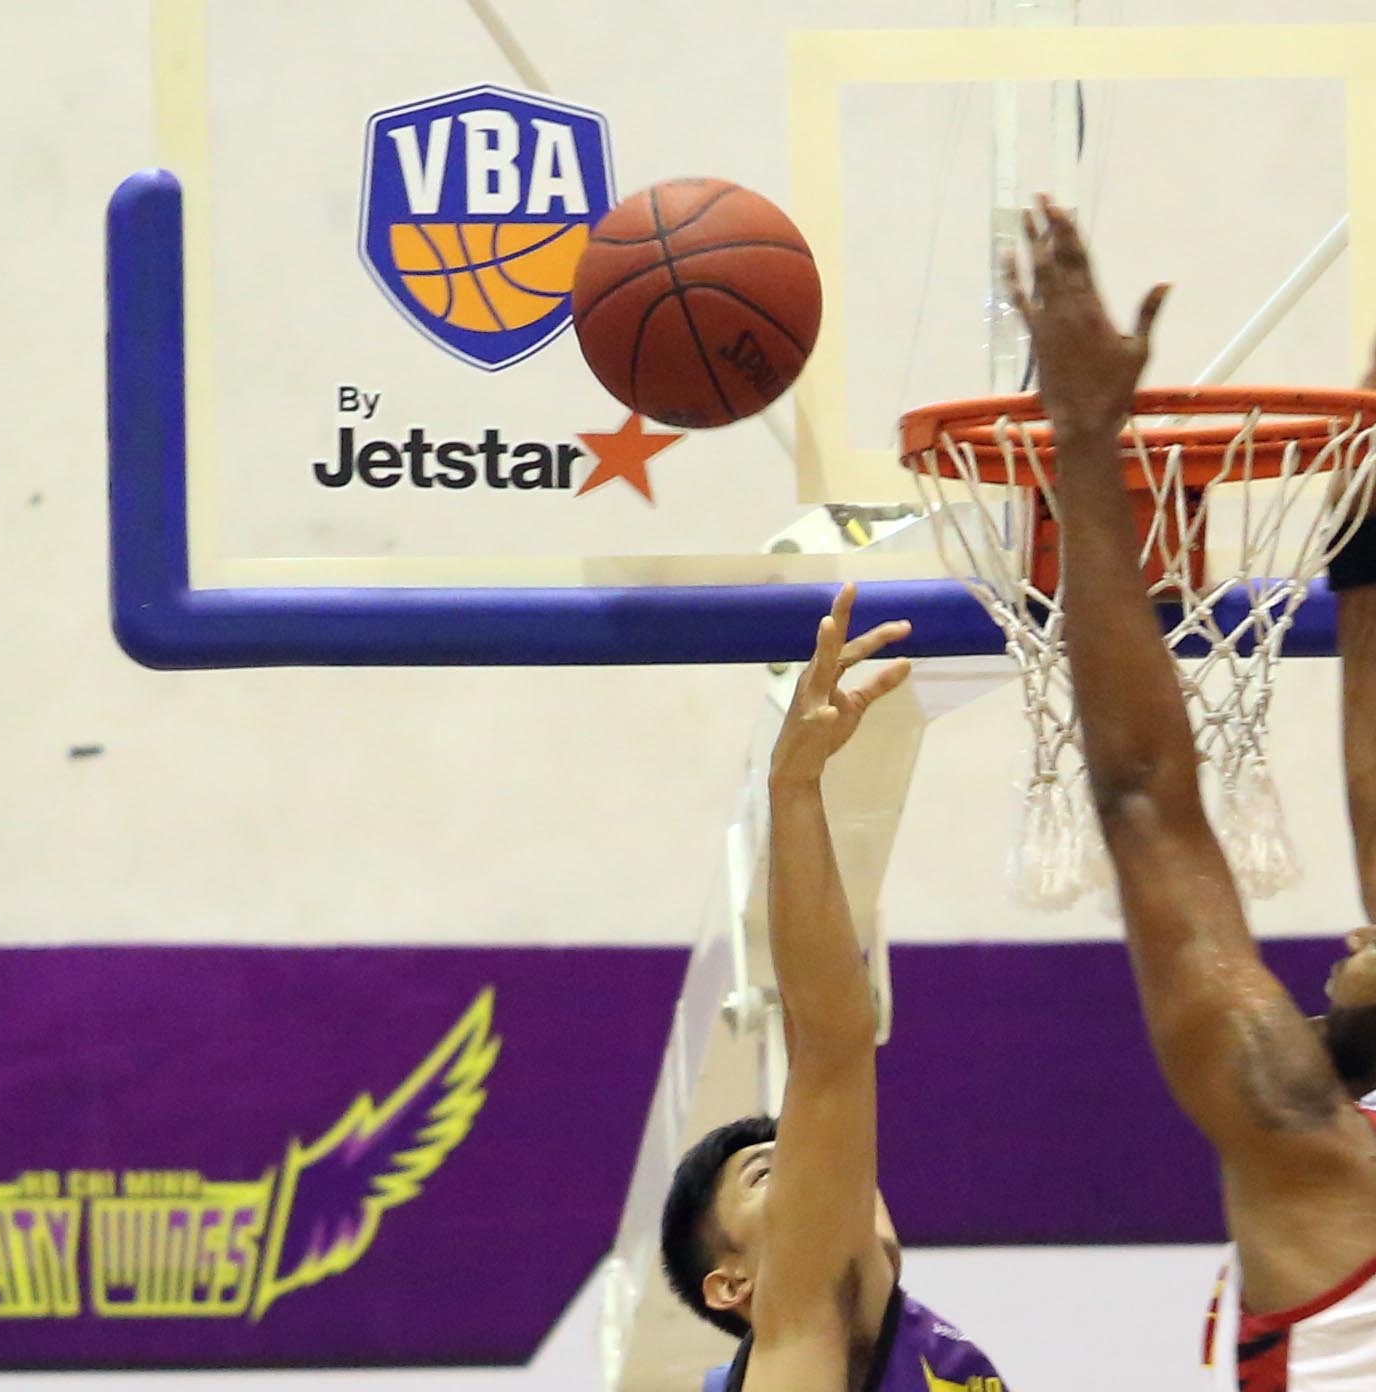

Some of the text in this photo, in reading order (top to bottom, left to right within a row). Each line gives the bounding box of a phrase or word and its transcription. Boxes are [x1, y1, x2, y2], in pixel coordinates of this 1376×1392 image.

[387, 108, 590, 216] VBA
[338, 386, 381, 420] By
[314, 428, 586, 490] Jetstar
